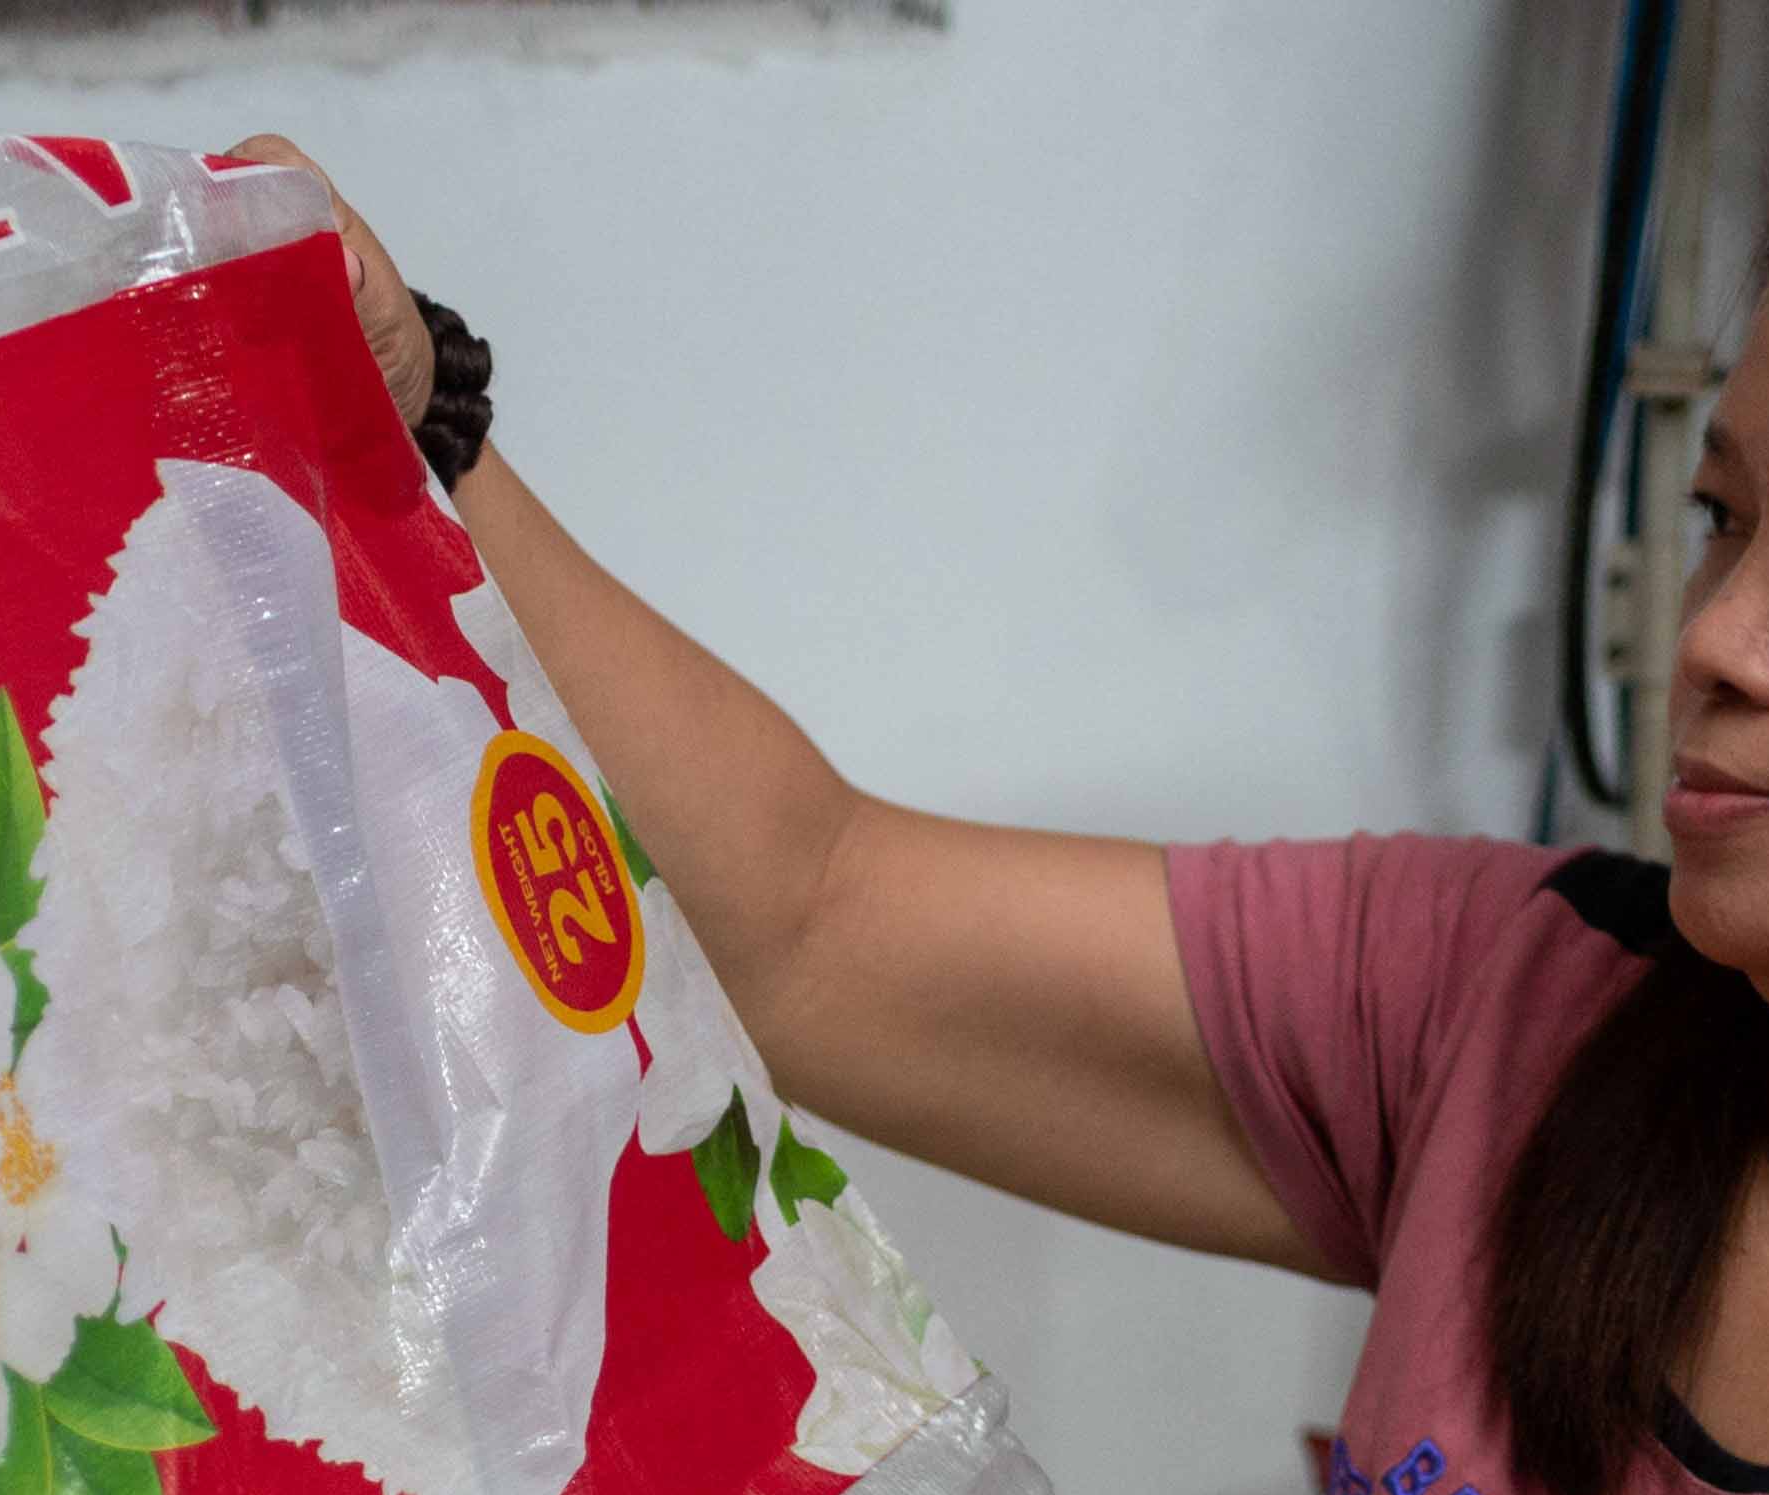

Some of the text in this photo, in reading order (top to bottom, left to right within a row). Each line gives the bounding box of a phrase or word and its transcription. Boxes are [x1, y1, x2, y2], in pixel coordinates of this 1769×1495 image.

[497, 822, 563, 984] NET WEIGHT
[513, 791, 618, 966] 25
[576, 816, 616, 897] KILOS
